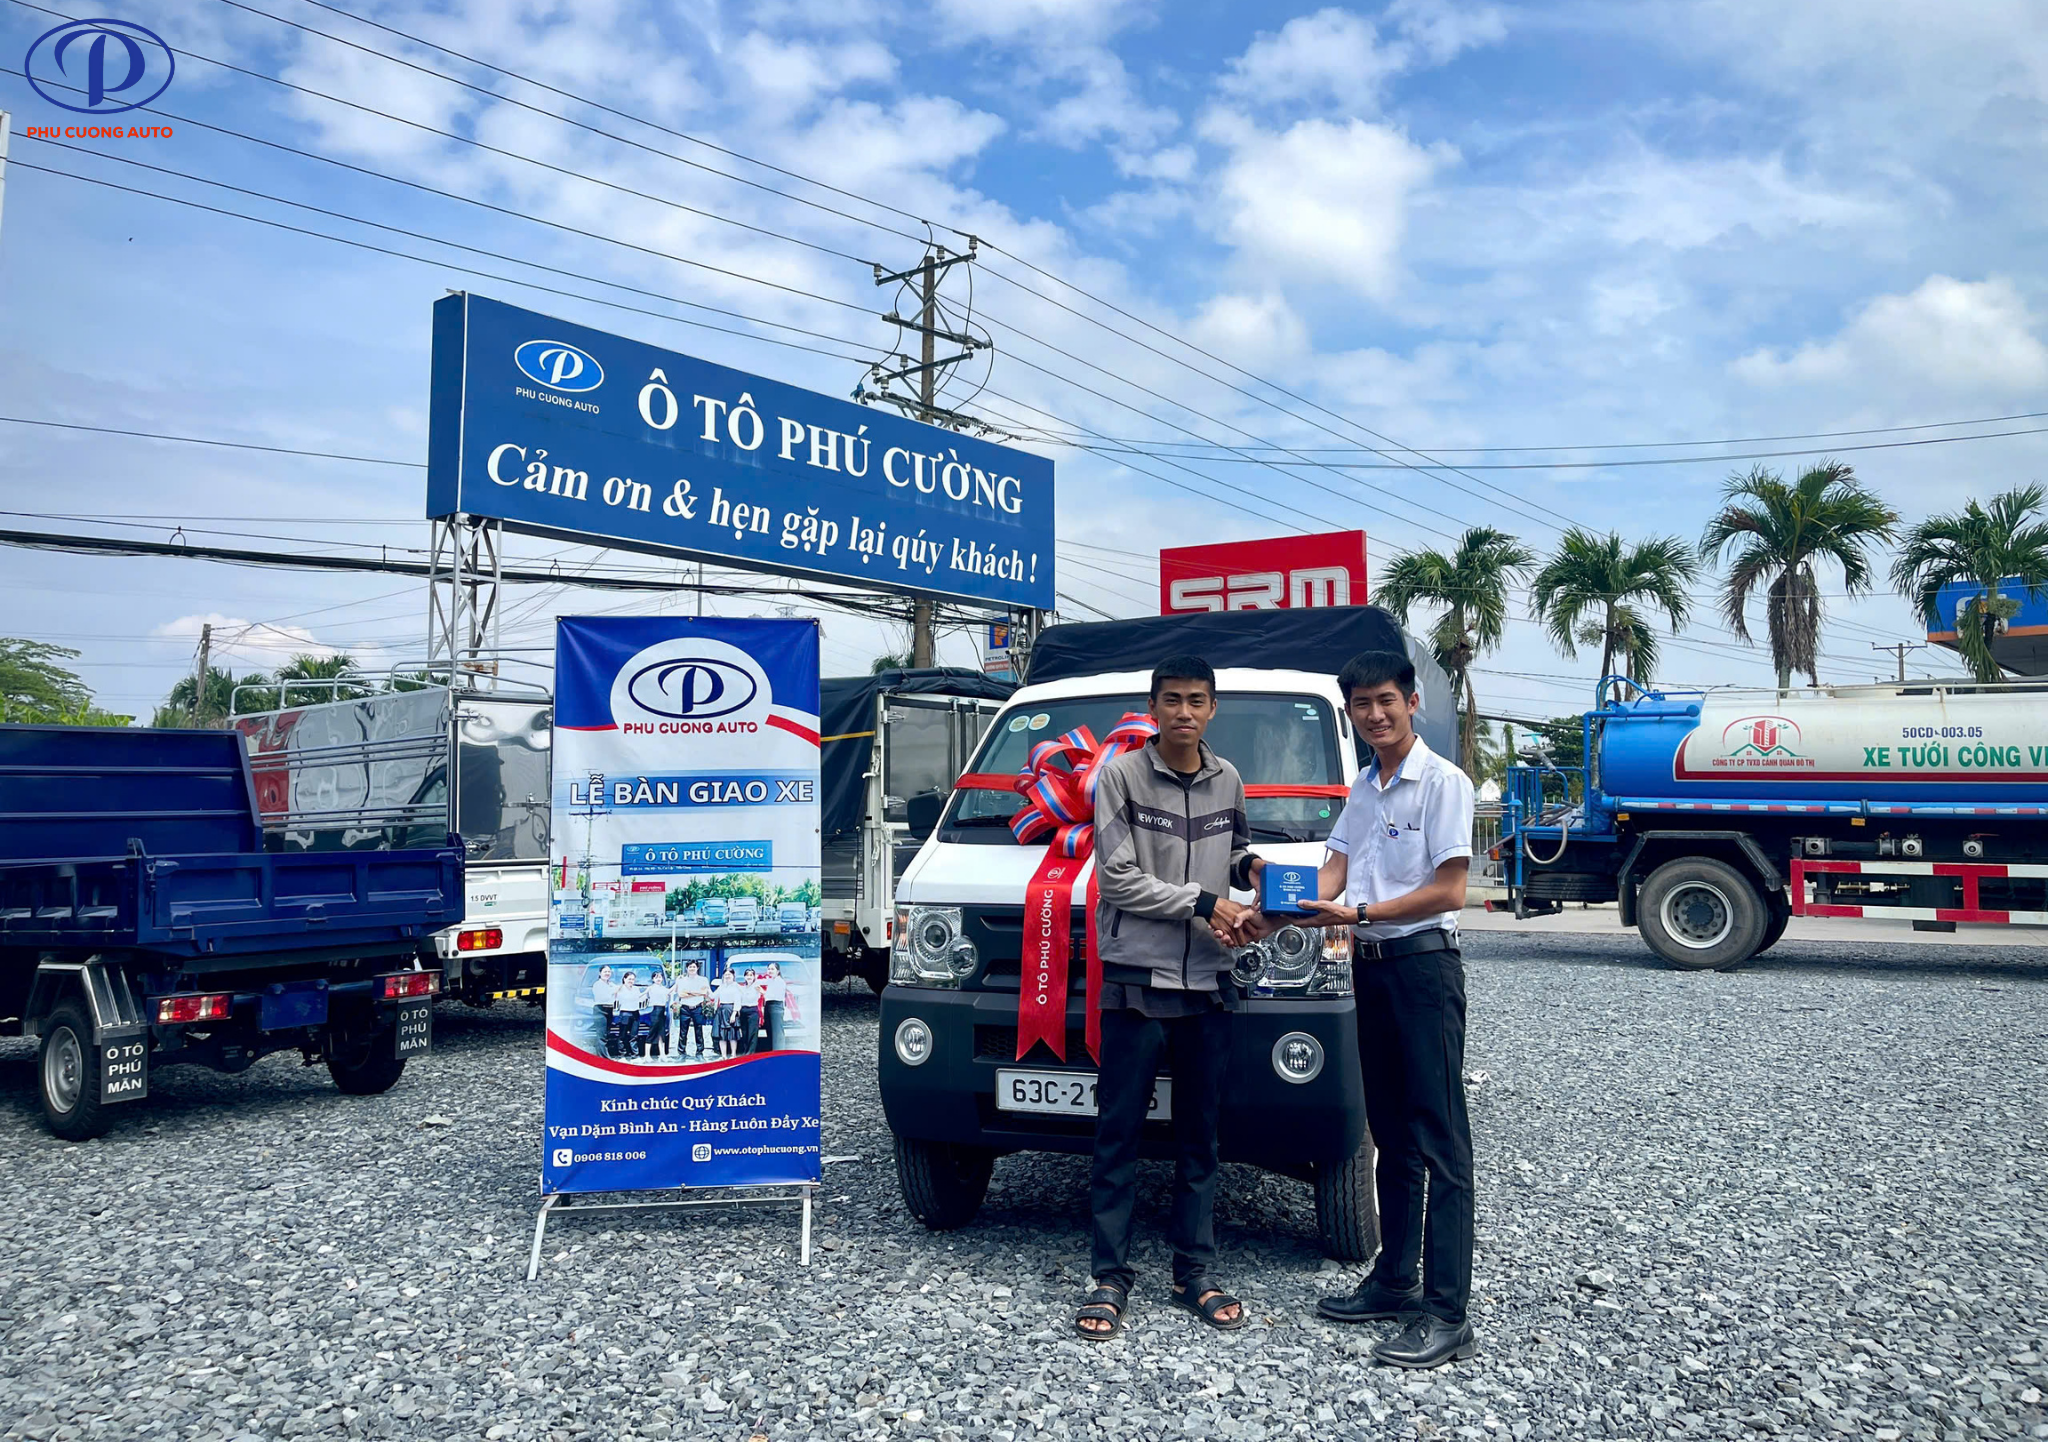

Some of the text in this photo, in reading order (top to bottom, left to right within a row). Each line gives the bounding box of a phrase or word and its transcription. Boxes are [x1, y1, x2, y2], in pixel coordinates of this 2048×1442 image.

[515, 386, 600, 415] PHU CUONG AUTO
[638, 367, 1024, 514] Ô TÔ PHÚ CƯỜNG
[487, 442, 589, 502] Cảm
[602, 476, 653, 513] ơn
[662, 478, 698, 520] &
[708, 486, 771, 541] hẹn
[780, 505, 839, 556] gặp
[848, 515, 886, 564] lại
[891, 528, 944, 575] qúy
[1170, 565, 1350, 612] SRM
[623, 721, 758, 735] PHU CUONG AUTO
[1712, 757, 1728, 767] CÔNG
[1729, 758, 1736, 767] TY
[1737, 758, 1745, 767] CP
[1863, 746, 1891, 767] XE
[1897, 740, 1949, 767] TƯỚI
[1957, 741, 2021, 768] CÔNG
[569, 774, 814, 806] LỄ BÀN GIAO XE
[644, 845, 764, 862] Ô TÔ PHÚ CƯỜNG
[1035, 889, 1054, 1005] Ô TÔ PHÚ CƯỜNG
[411, 1006, 429, 1020] TÔ
[401, 1021, 427, 1036] PHÚ
[106, 1042, 144, 1060] Ô TÔ
[108, 1058, 142, 1077] PHÚ
[600, 1093, 767, 1112] Kính chúc Quý Khách
[549, 1125, 578, 1140] Vạn
[580, 1123, 616, 1139] Dặm
[619, 1121, 654, 1135] Bình
[657, 1121, 678, 1133] An
[689, 1119, 728, 1132] Hàng
[730, 1117, 768, 1130] Luôn
[770, 1114, 800, 1131] Đầy
[801, 1116, 819, 1129] Xe
[574, 1150, 647, 1163] 0906 818 006
[713, 1144, 819, 1156] www.otophucuong.vn
